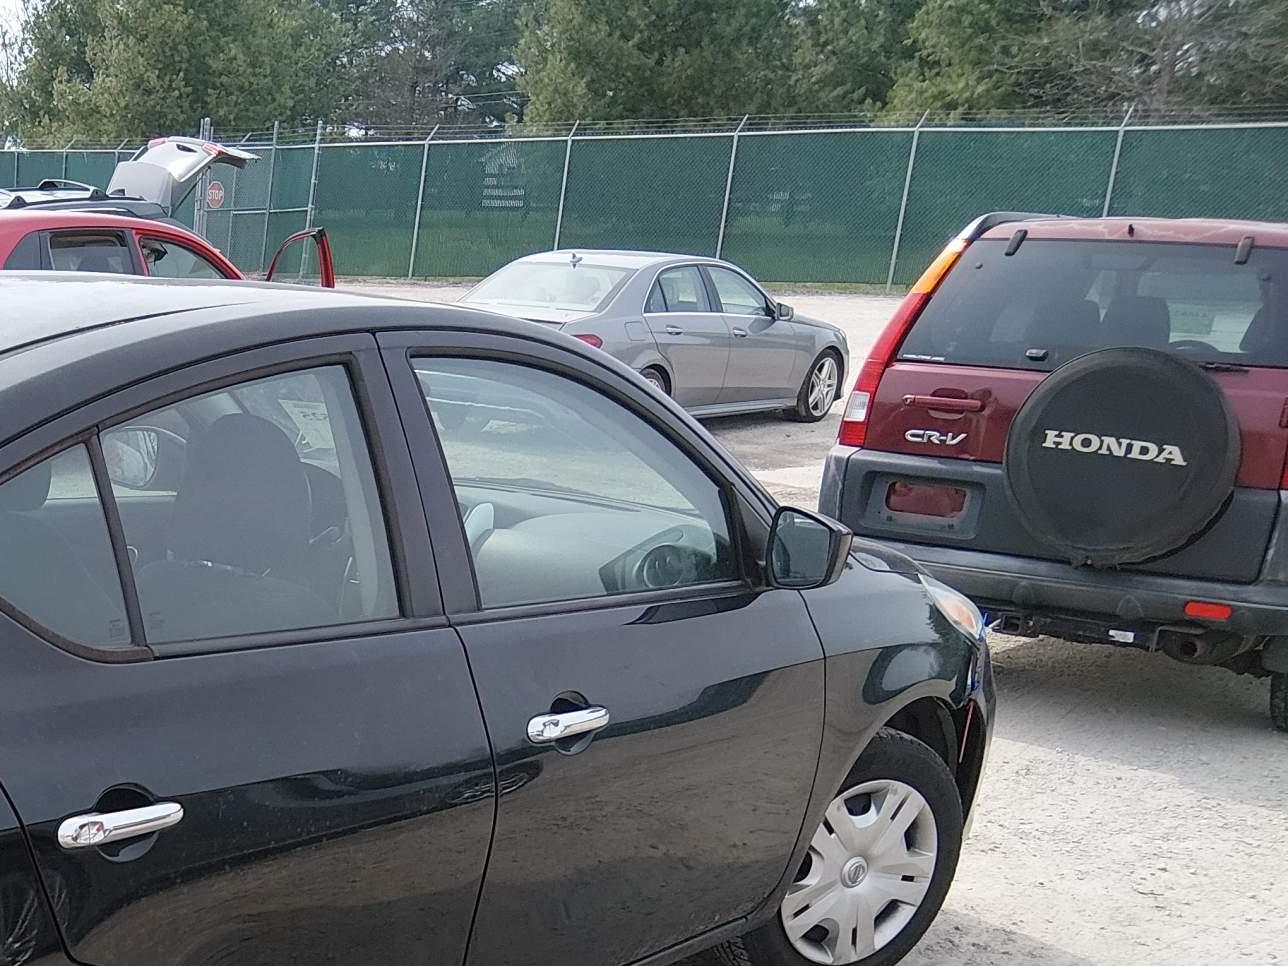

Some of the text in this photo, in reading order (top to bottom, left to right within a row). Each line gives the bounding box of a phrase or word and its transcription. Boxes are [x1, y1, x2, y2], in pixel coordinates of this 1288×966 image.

[208, 190, 224, 201] STOP
[904, 429, 968, 446] CR-V
[1041, 429, 1188, 467] HONDA
